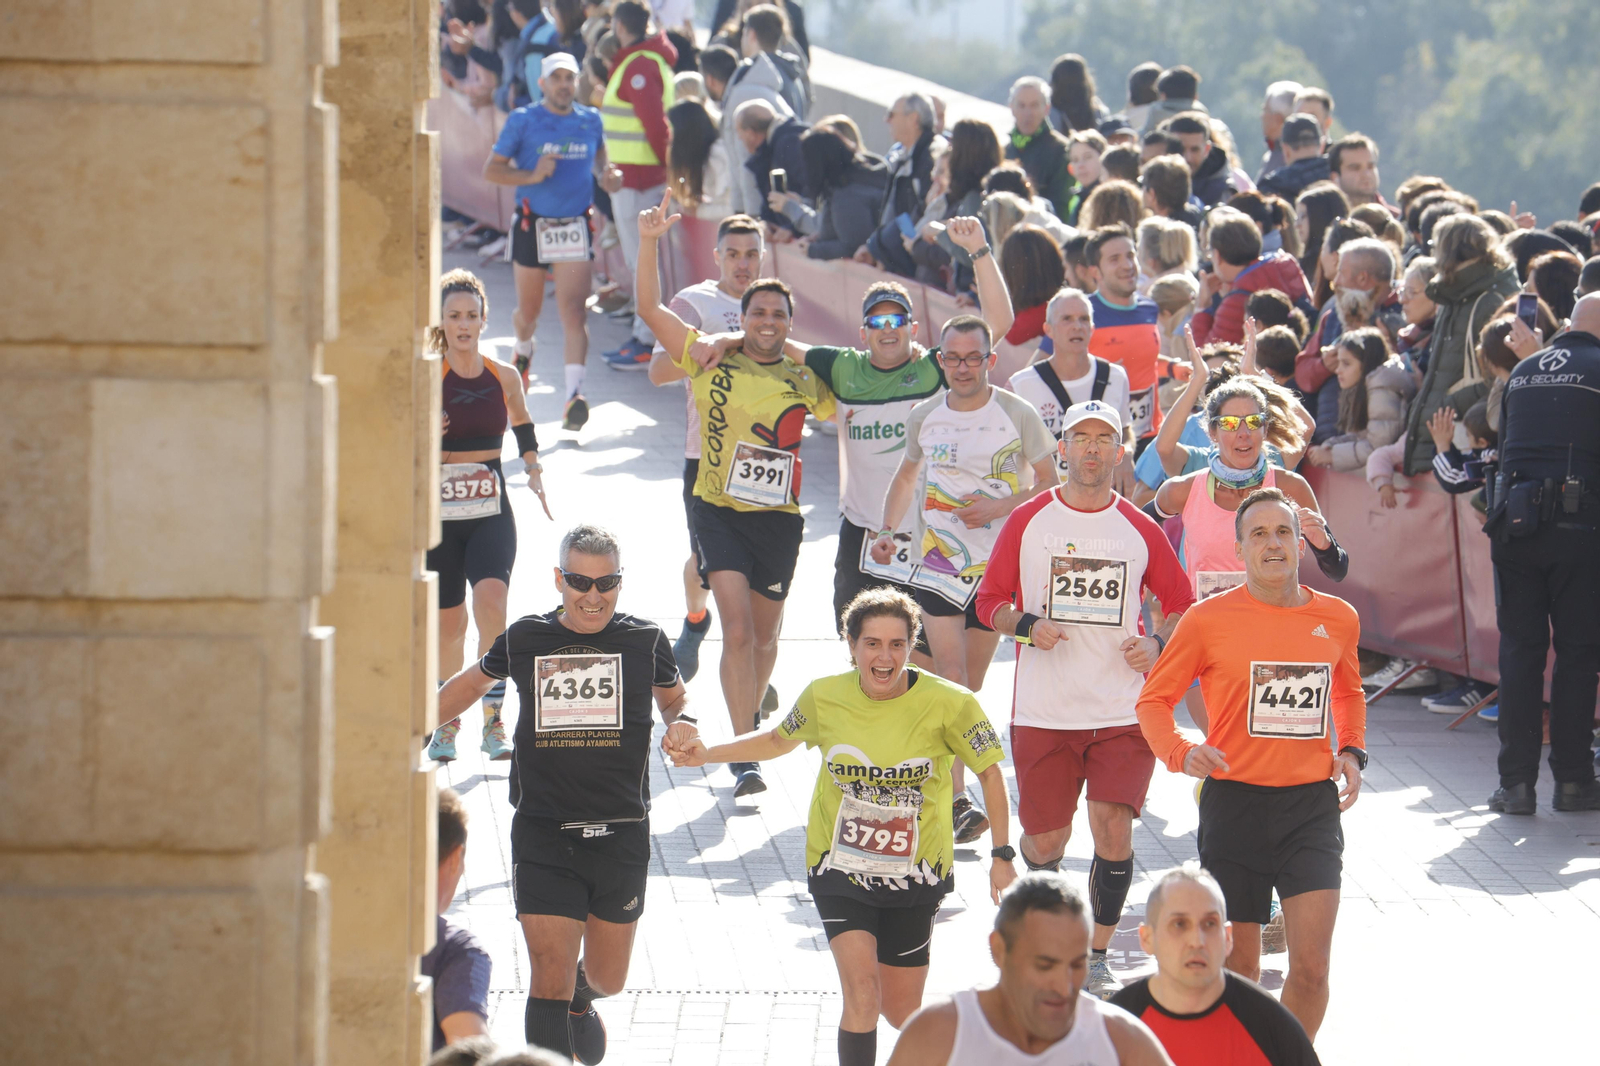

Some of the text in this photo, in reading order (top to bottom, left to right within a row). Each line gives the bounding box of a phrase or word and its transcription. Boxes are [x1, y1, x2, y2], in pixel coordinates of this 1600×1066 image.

[544, 230, 581, 245] 5190
[1530, 373, 1585, 384] SECURITY
[707, 363, 741, 468] CÓRDOBA
[848, 420, 905, 440] inatec
[739, 462, 784, 487] 3991
[441, 479, 493, 500] 3578
[1043, 533, 1125, 553] Cruzcampo
[1054, 576, 1120, 600] 2568
[543, 677, 614, 701] 4365
[1259, 686, 1322, 709] 4421
[535, 739, 621, 748] CLUB ATLETISMO AYAMONTE
[550, 730, 586, 739] CARRERA
[587, 730, 621, 738] PLAYERA
[827, 761, 930, 782] campañas
[842, 820, 908, 853] 3795
